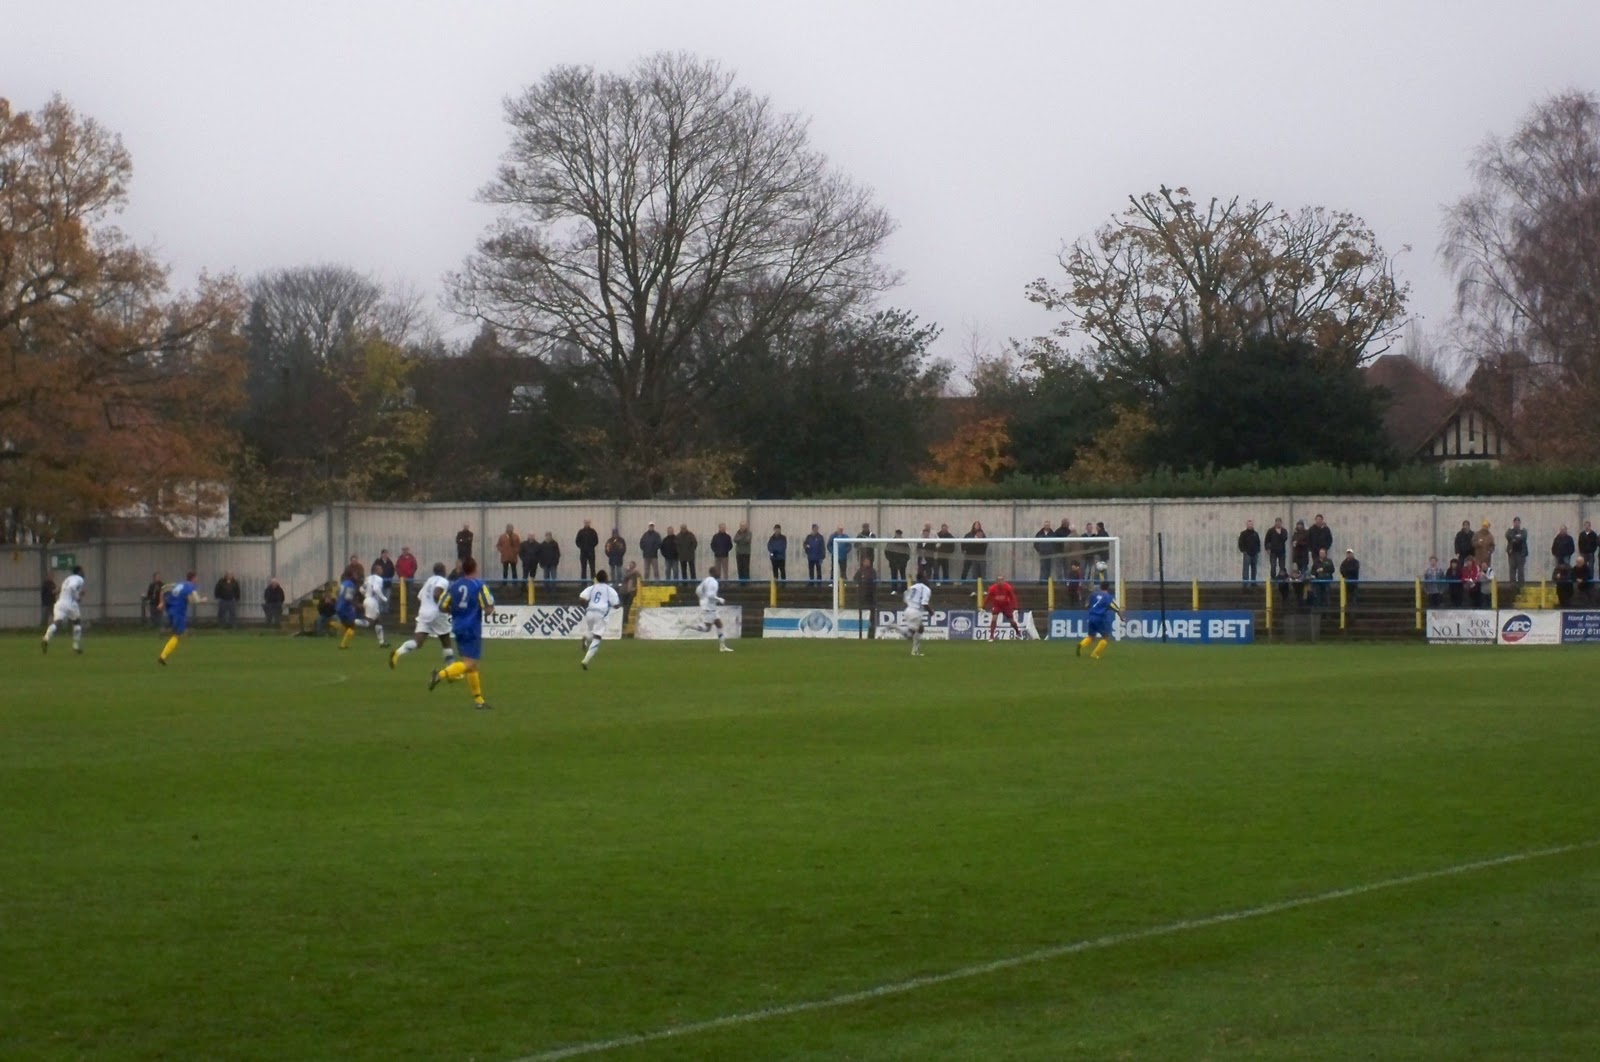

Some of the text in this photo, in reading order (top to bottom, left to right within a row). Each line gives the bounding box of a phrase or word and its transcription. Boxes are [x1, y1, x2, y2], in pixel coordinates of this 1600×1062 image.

[458, 585, 468, 608] 2
[594, 591, 602, 604] 6
[1093, 595, 1103, 608] 7
[523, 608, 549, 635] BILL
[978, 610, 1028, 627] BLU
[1471, 619, 1490, 628] FOR
[489, 628, 516, 637] Group
[1051, 619, 1251, 638] BLU SQUARE BET
[1467, 628, 1494, 637] NEWS
[1507, 621, 1530, 632] APC
[1564, 628, 1586, 636] 01727
[976, 630, 1006, 640] 0127
